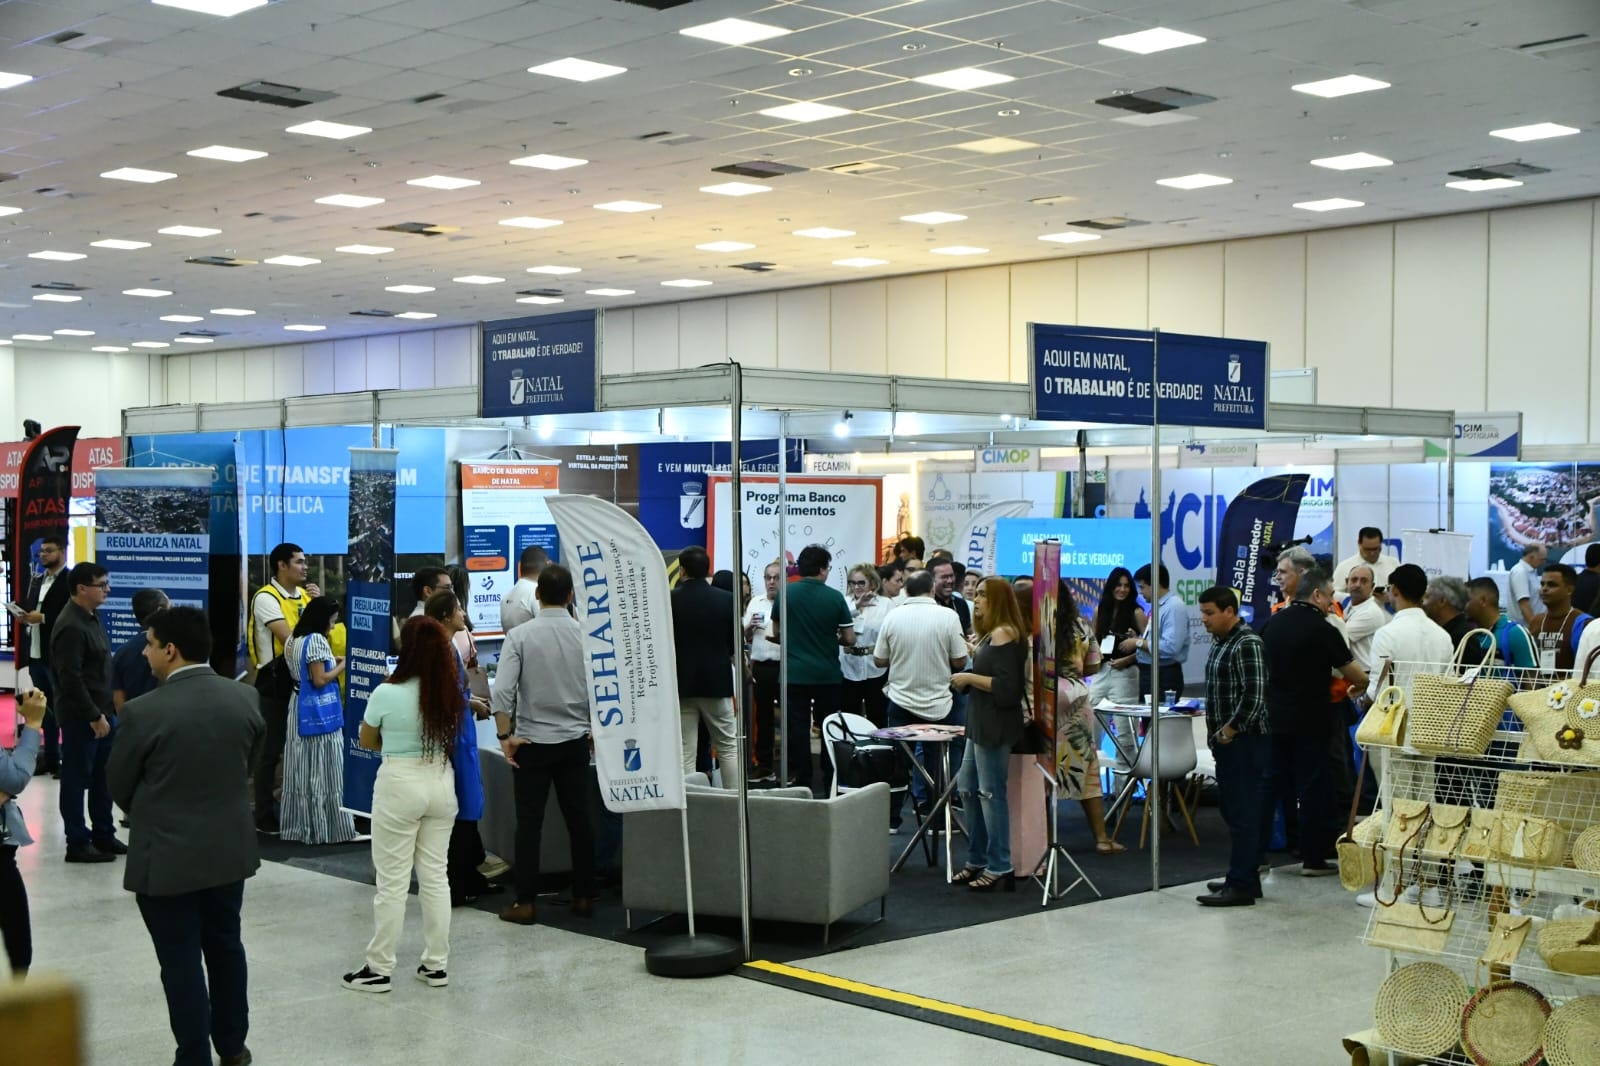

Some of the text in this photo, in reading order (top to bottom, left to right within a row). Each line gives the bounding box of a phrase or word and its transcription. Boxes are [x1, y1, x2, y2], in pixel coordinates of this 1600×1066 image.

[492, 330, 539, 345] AQUI EM NATAL,
[492, 342, 583, 361] O TRABALHO É DE VERDADE!
[1043, 349, 1131, 373] AQUI EM NATAL,
[526, 375, 564, 393] NATAL
[1044, 376, 1052, 394] O
[1054, 377, 1125, 397] TRABALHO
[1128, 377, 1134, 398] É
[1136, 382, 1151, 399] DE
[525, 393, 564, 404] PREFEITURA
[1213, 384, 1255, 403] NATAL
[1213, 402, 1255, 414] PREFEITURA
[1463, 423, 1482, 432] CIM
[88, 447, 113, 464] ATAS
[982, 448, 1030, 464] CIMOP
[496, 467, 504, 475] DE
[505, 467, 539, 475] ALIMENTOS
[658, 463, 663, 473] E
[665, 463, 682, 473] VEM
[684, 463, 712, 473] MUITO
[758, 463, 781, 473] FRENT
[72, 472, 96, 489] DISP
[1302, 477, 1334, 497] IM
[251, 490, 324, 514] PÚBLICA
[746, 490, 847, 504] Programa Banco
[25, 497, 66, 516] ATAS
[756, 504, 836, 517] de Aimentos
[106, 536, 203, 550] REGULARIZA NATAL
[748, 524, 813, 560] BANCO
[1022, 551, 1028, 564] O
[1072, 550, 1077, 565] É
[1078, 552, 1088, 566] DE
[1089, 552, 1124, 566] VERDADE!
[1241, 517, 1263, 603] Empreendedor
[1232, 559, 1246, 589] Sala
[474, 593, 501, 604] SEMTAS
[627, 567, 639, 620] Fundiária
[618, 597, 627, 610] de
[353, 616, 371, 629] NATAL
[640, 566, 658, 688] Projetos Estruturantes
[576, 541, 623, 727] SEHARPE
[619, 612, 633, 667] Municipal
[351, 647, 386, 661] REGULARIZAR
[633, 622, 646, 698] Regularização
[351, 659, 356, 671] É
[350, 688, 355, 698] E
[609, 783, 664, 802] NATAL
